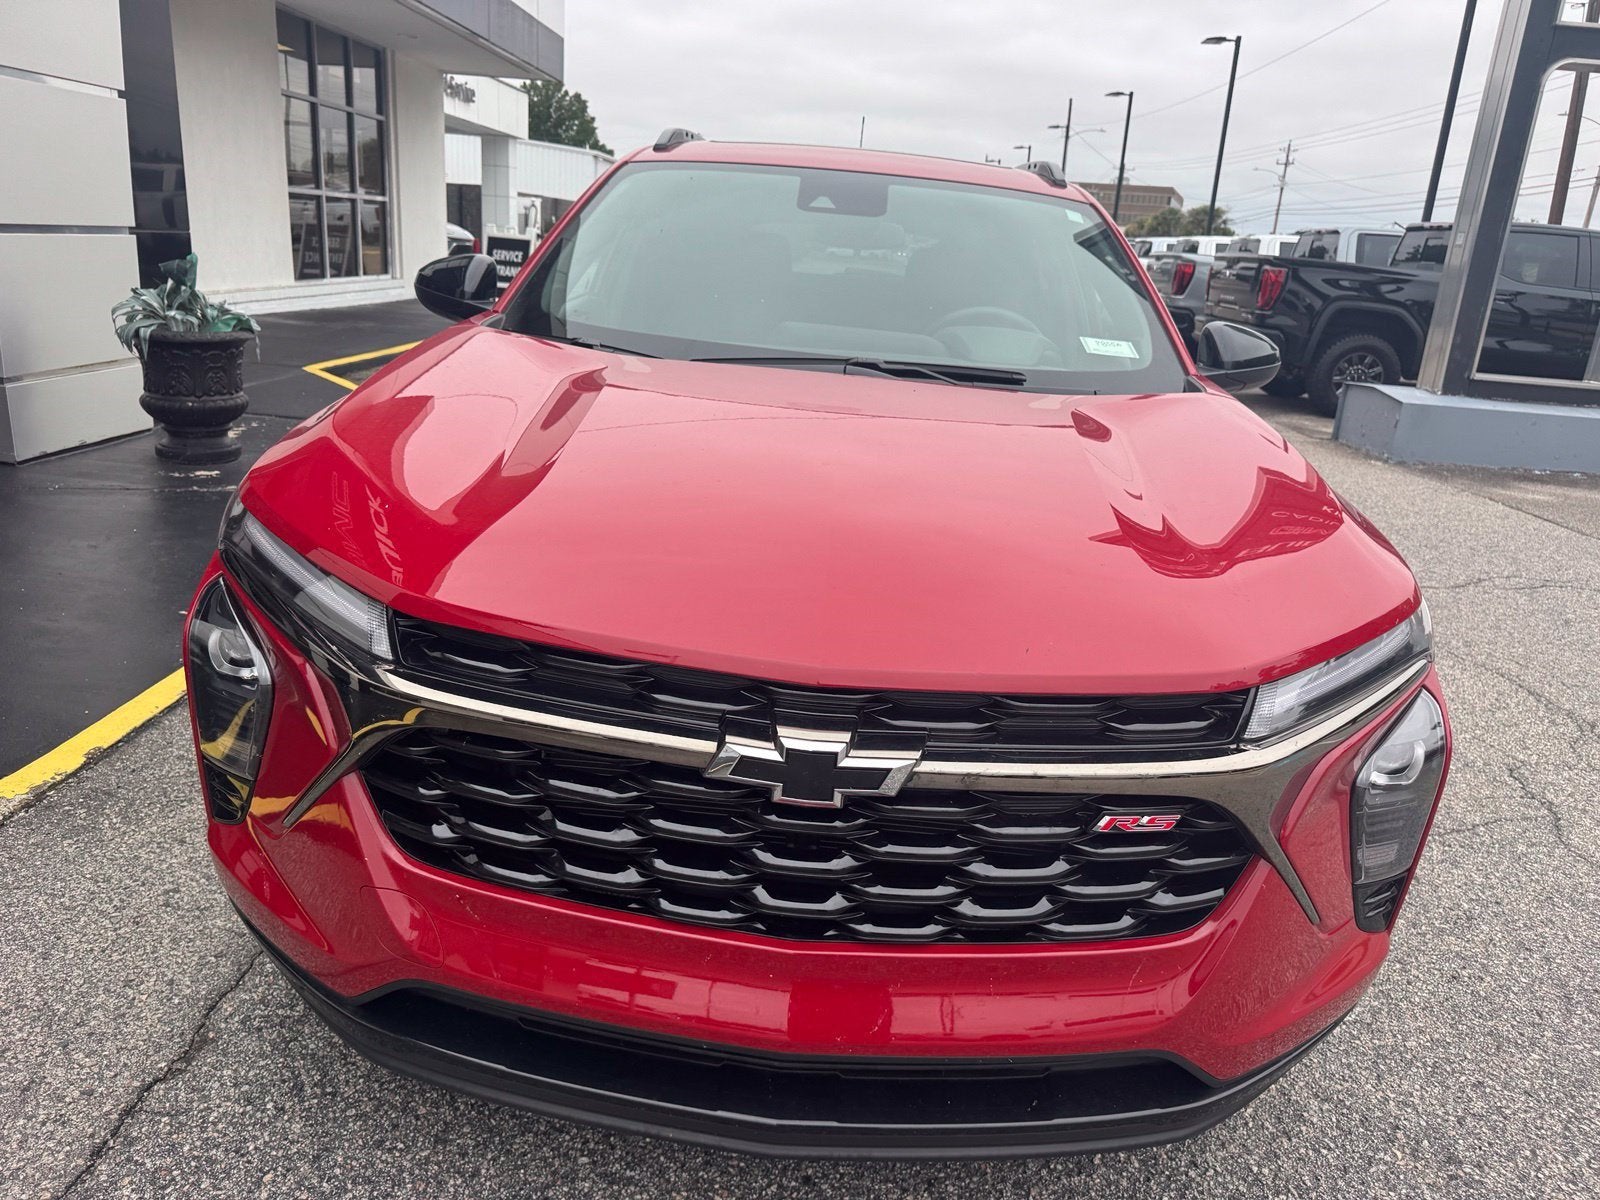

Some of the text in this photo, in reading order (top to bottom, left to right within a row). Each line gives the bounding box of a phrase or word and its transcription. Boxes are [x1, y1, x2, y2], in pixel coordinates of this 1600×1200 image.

[492, 249, 524, 262] SERVICE
[496, 265, 521, 277] TRAN
[1092, 815, 1181, 832] RS
